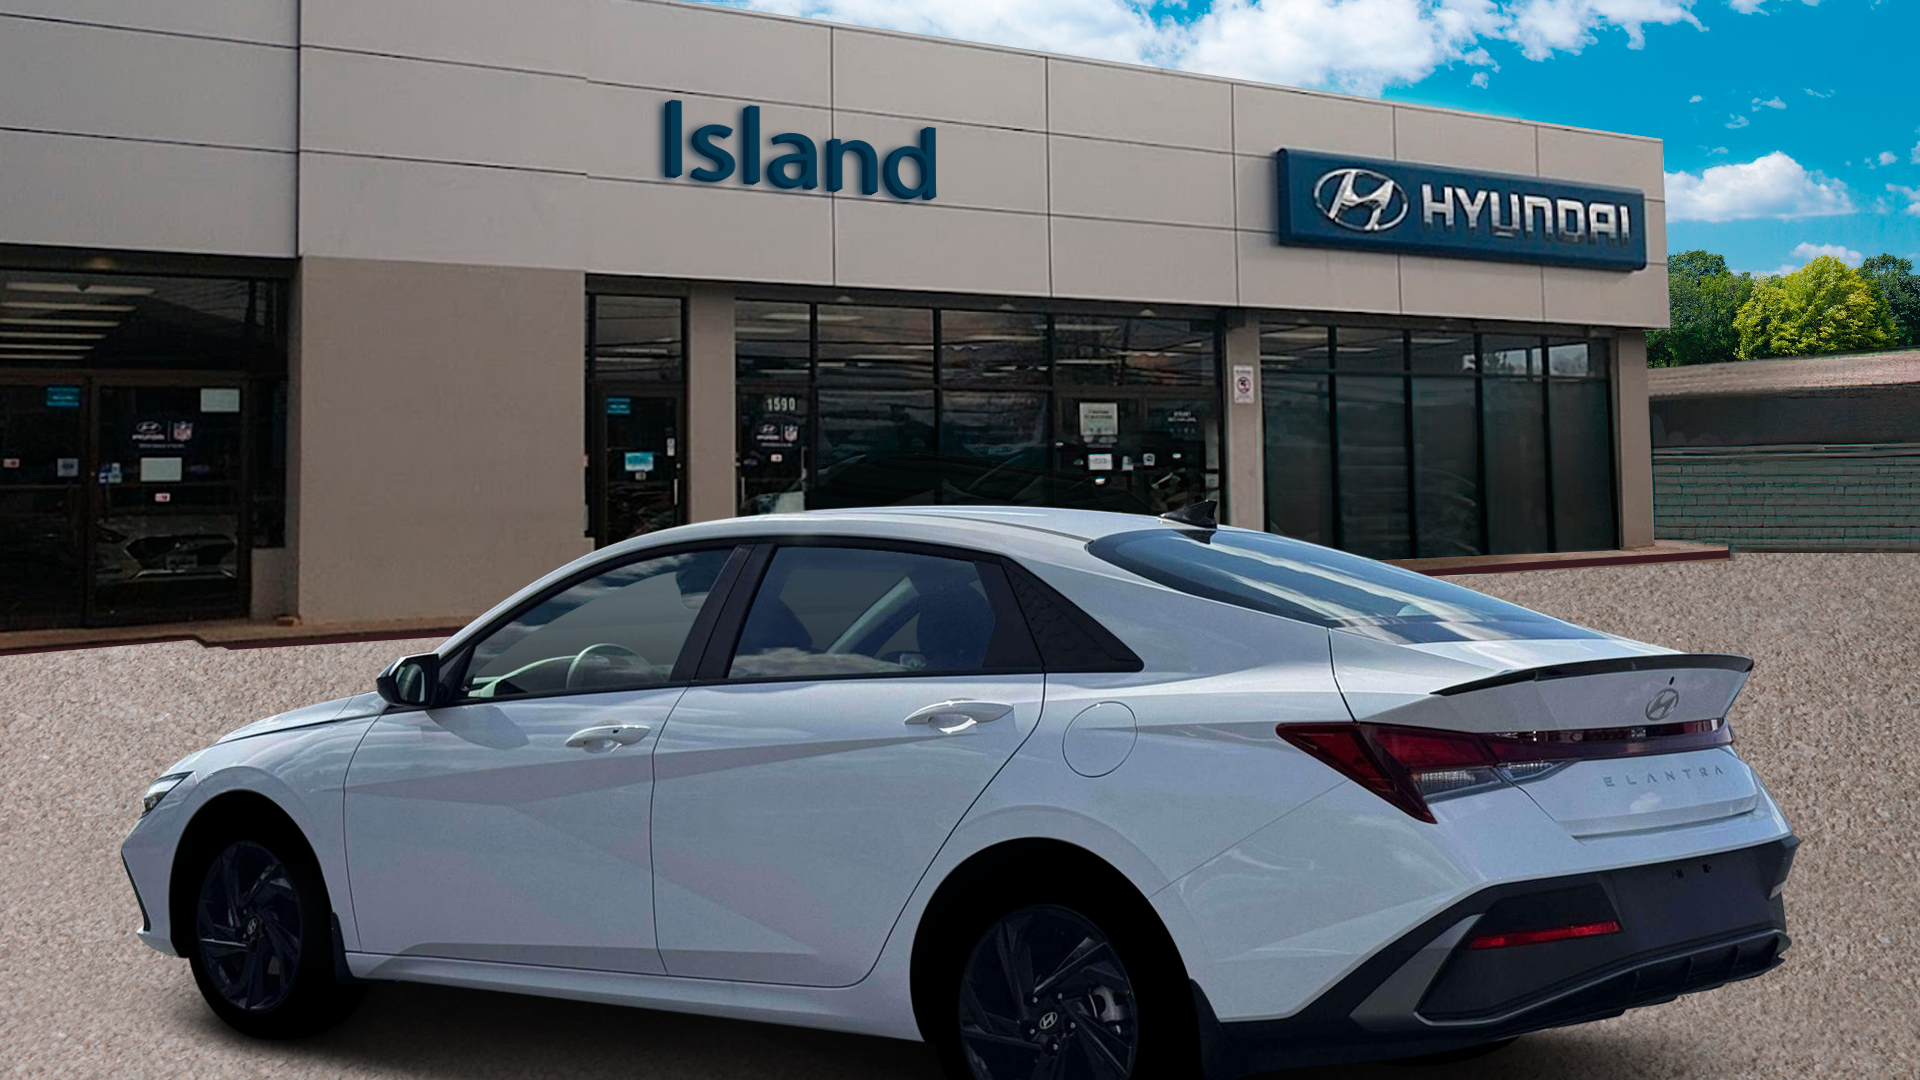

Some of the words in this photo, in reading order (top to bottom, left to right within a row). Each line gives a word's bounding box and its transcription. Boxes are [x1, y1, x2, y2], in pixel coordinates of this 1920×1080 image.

[664, 99, 937, 200] Island
[1421, 184, 1630, 244] HYUNDAI
[767, 396, 796, 412] 1590
[1602, 765, 1724, 787] ELANTRA
